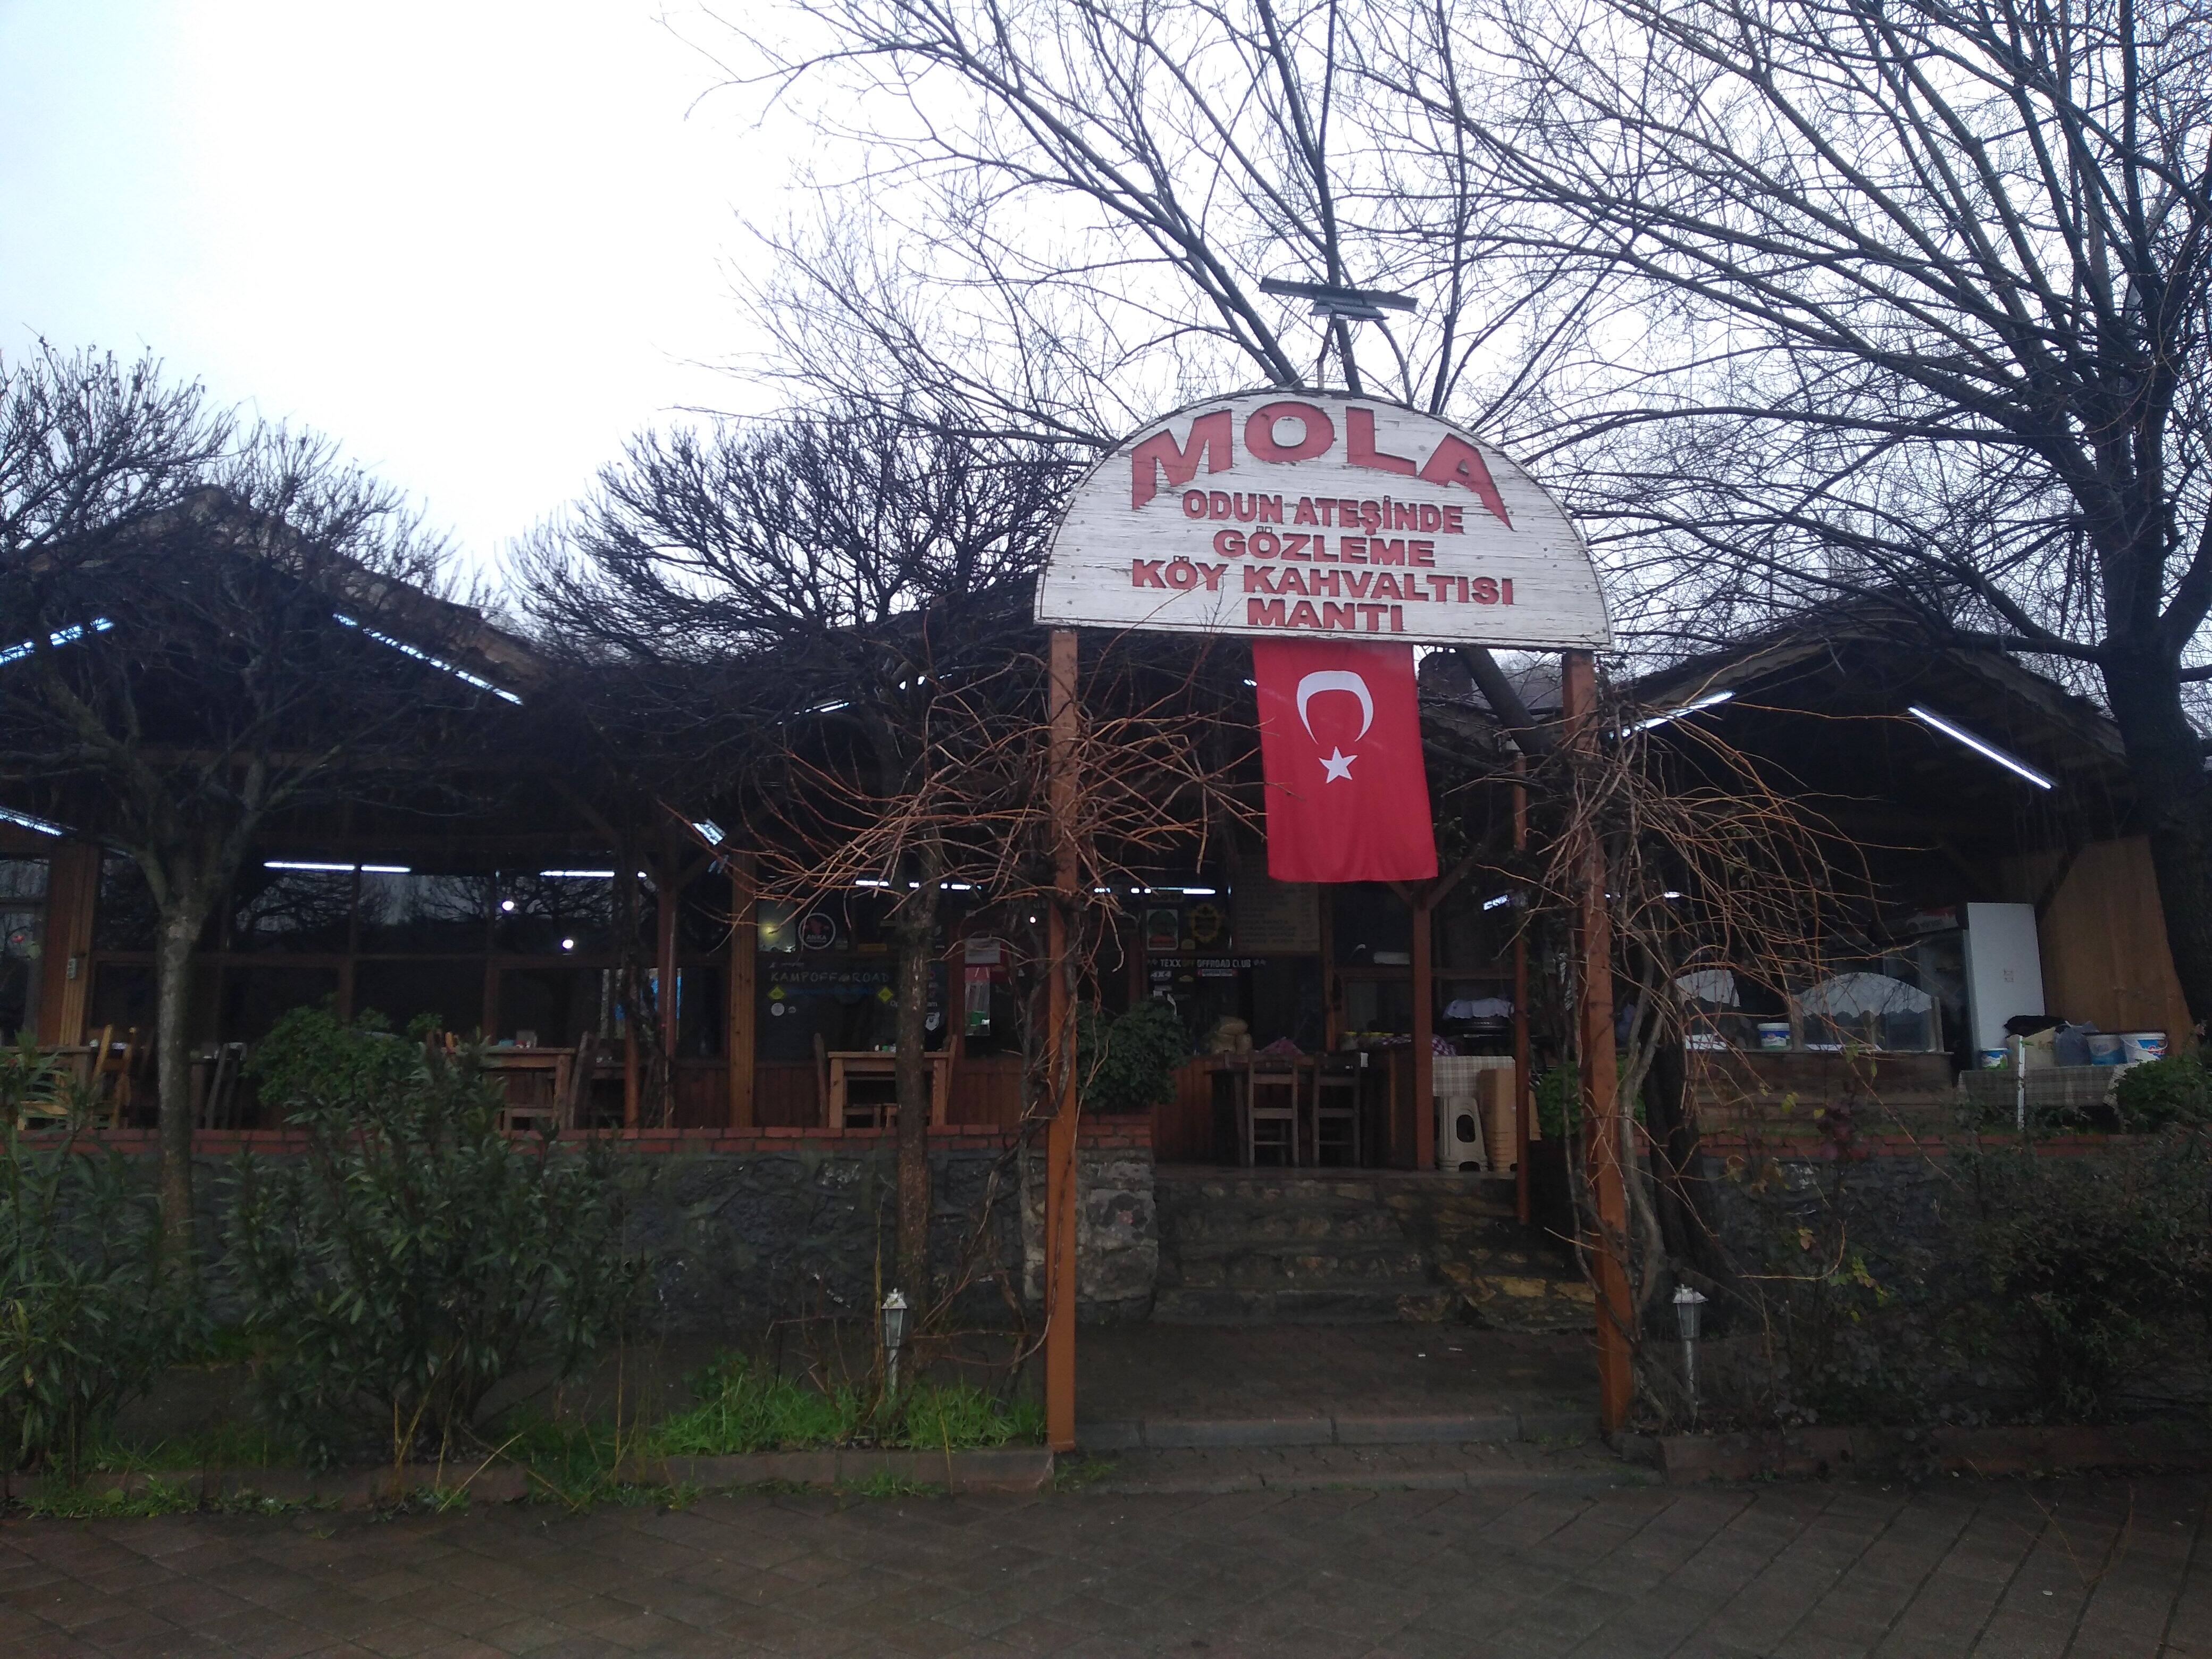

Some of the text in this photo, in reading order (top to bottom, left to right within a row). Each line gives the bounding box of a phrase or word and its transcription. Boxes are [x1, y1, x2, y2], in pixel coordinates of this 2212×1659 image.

[1132, 401, 1514, 532] MOLA
[1183, 489, 1465, 535] ODUN ATEŞİNDE
[1213, 525, 1435, 567] GÖZLEME
[1133, 556, 1513, 605] KÖY KAHVALTISI
[1247, 598, 1403, 631] MANTI
[852, 972, 890, 983] ROAD
[1232, 959, 1251, 968] CLUB
